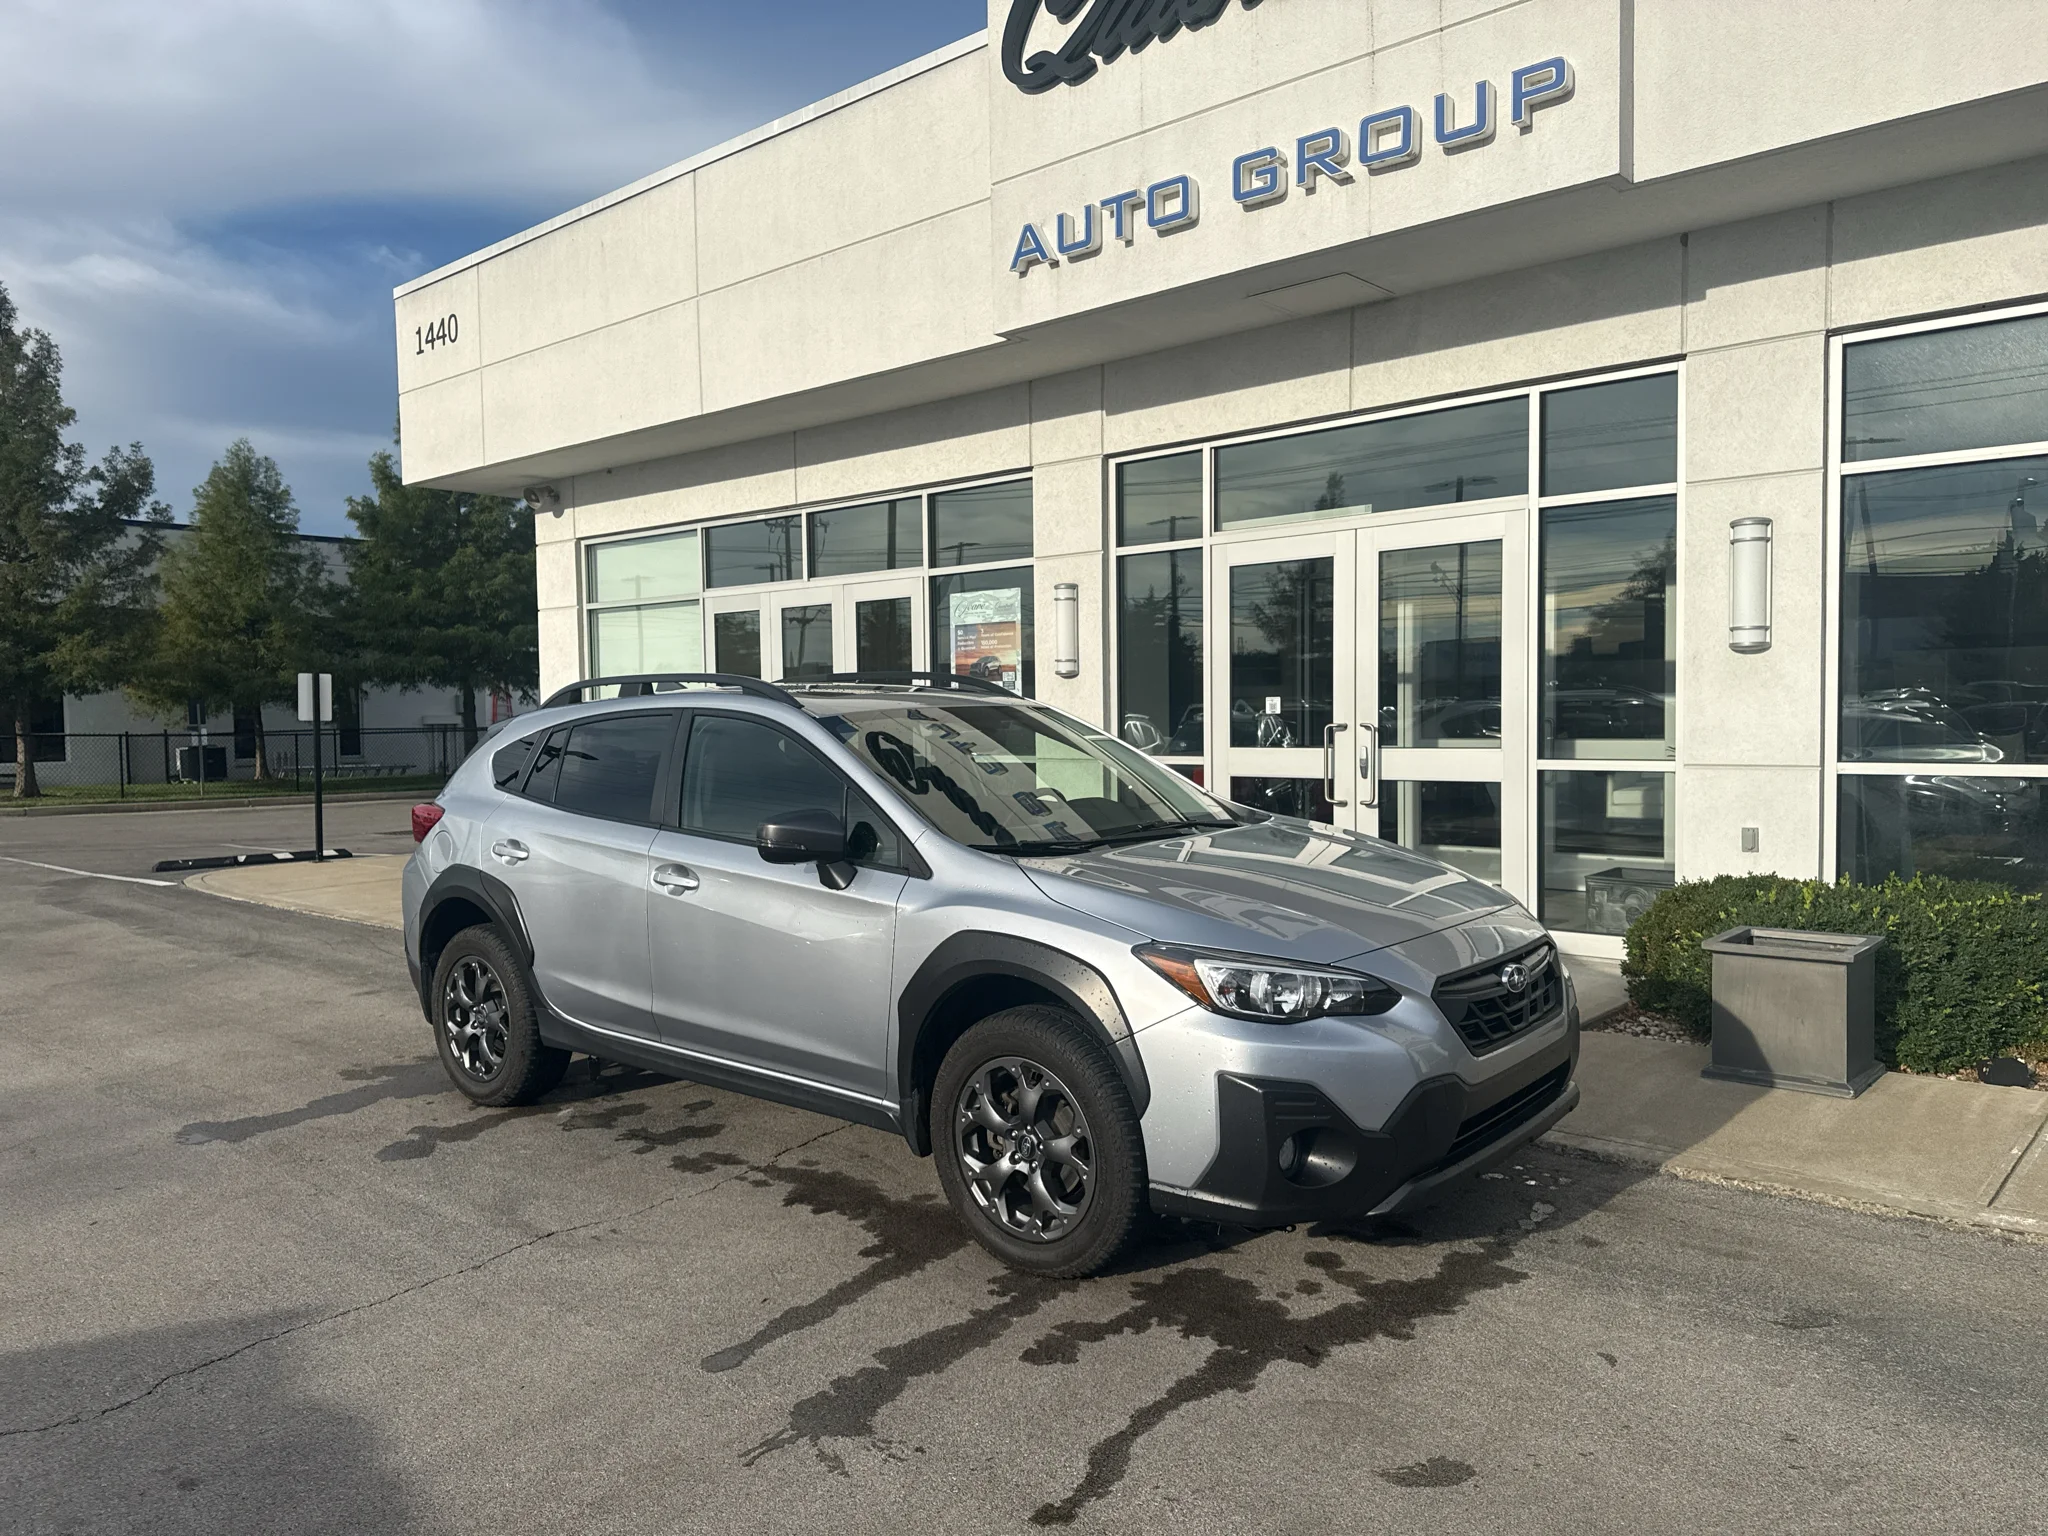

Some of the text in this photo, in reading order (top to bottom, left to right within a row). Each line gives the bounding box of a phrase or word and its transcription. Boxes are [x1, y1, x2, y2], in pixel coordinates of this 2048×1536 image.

[1009, 56, 1575, 275] AUTO GROUP
[416, 313, 458, 355] 1440
